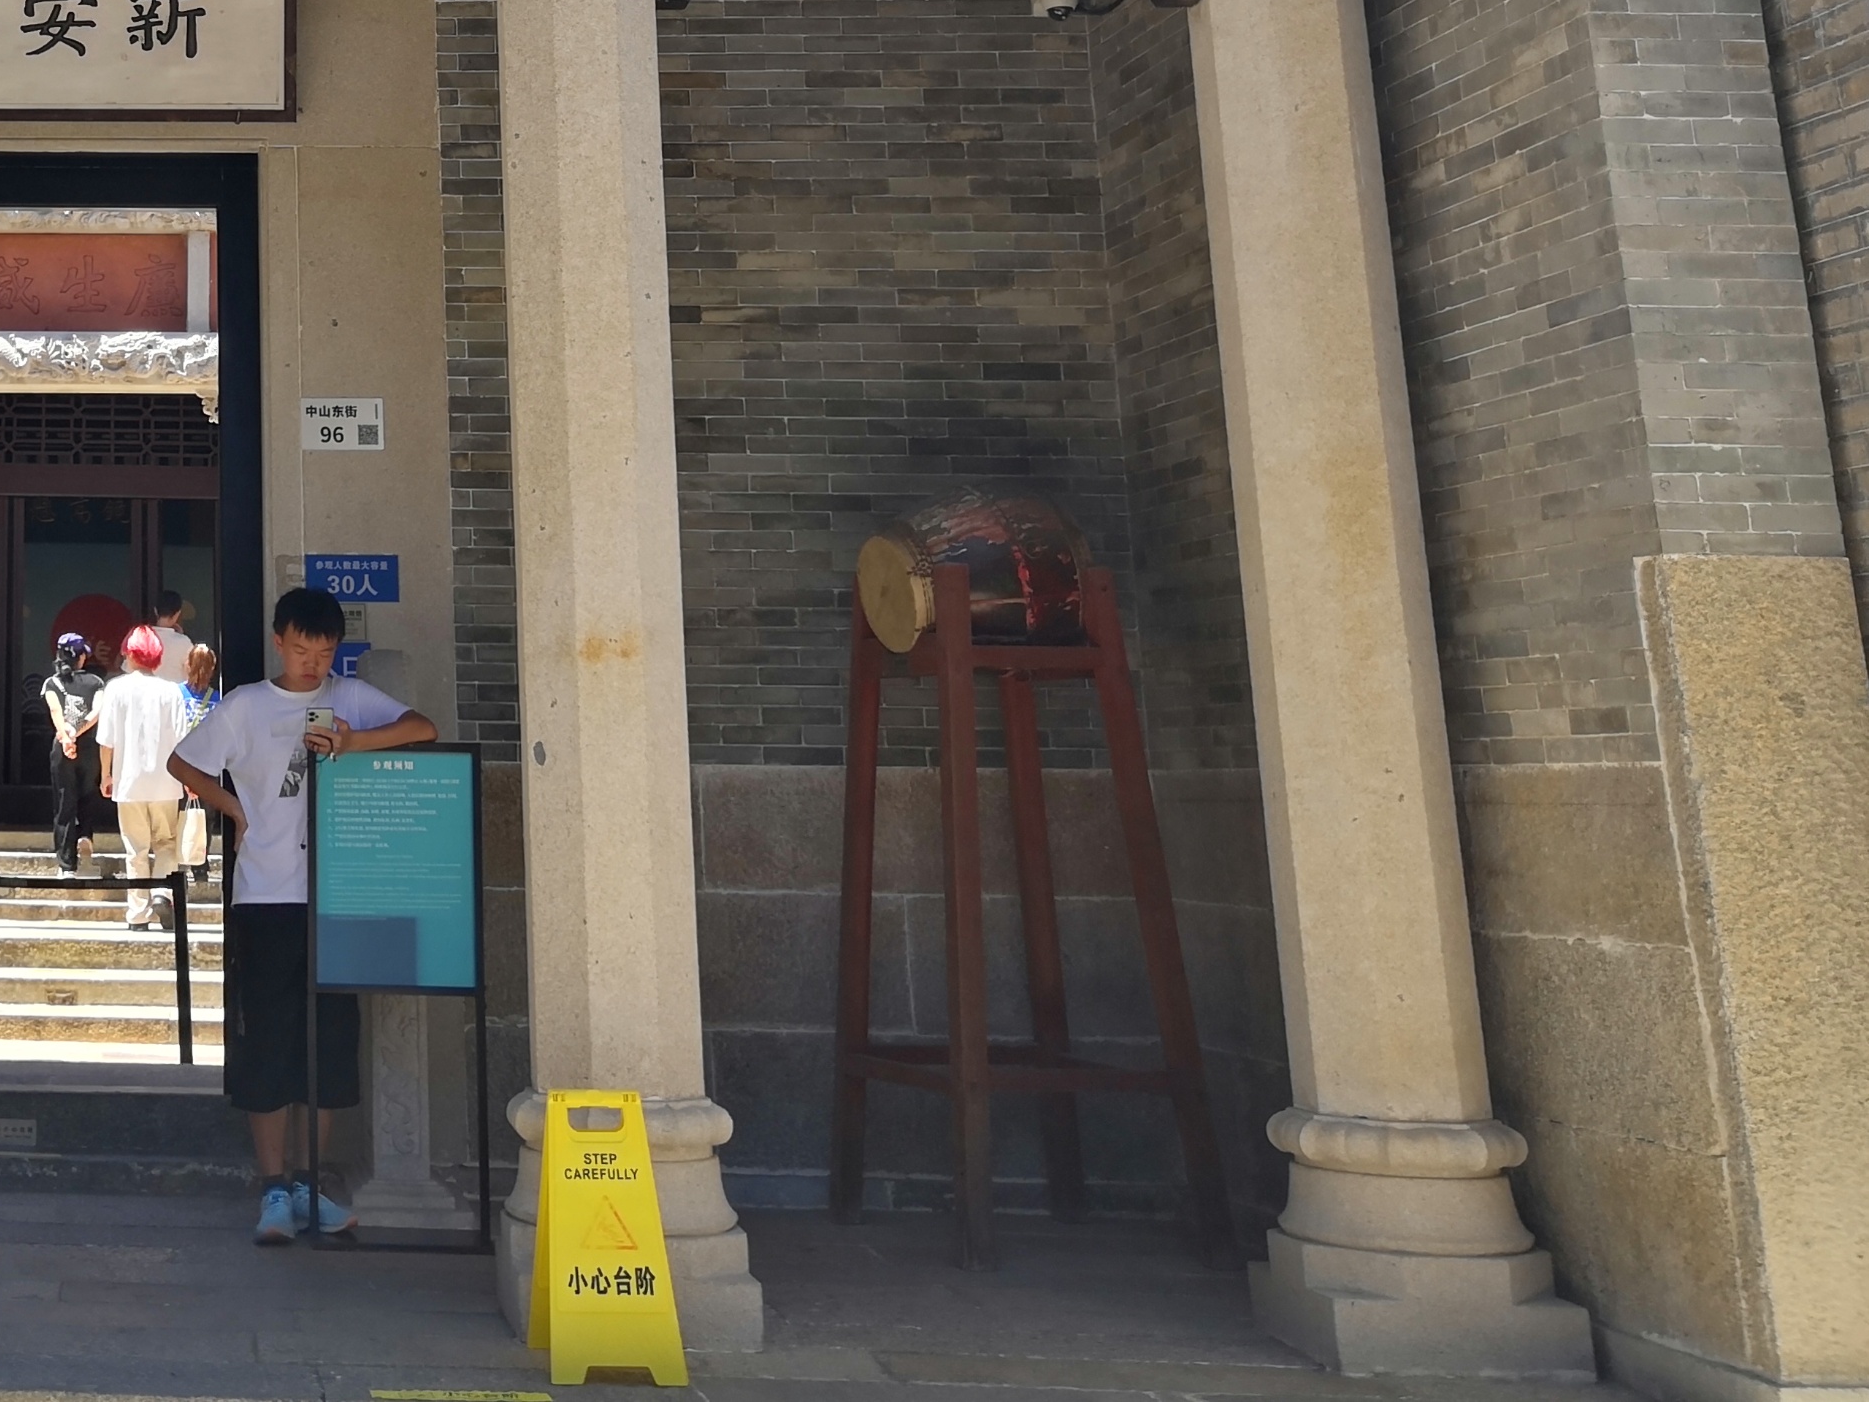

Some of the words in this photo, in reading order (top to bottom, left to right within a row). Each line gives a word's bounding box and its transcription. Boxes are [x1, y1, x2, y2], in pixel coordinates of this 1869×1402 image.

[305, 405, 358, 418] 中山东街
[320, 426, 345, 444] 96
[315, 560, 388, 571] 参观人数最大容量
[327, 573, 379, 597] 30人
[583, 1153, 617, 1165] STEP
[564, 1168, 639, 1180] CAREFULLY
[567, 1265, 656, 1296] 小心台阶
